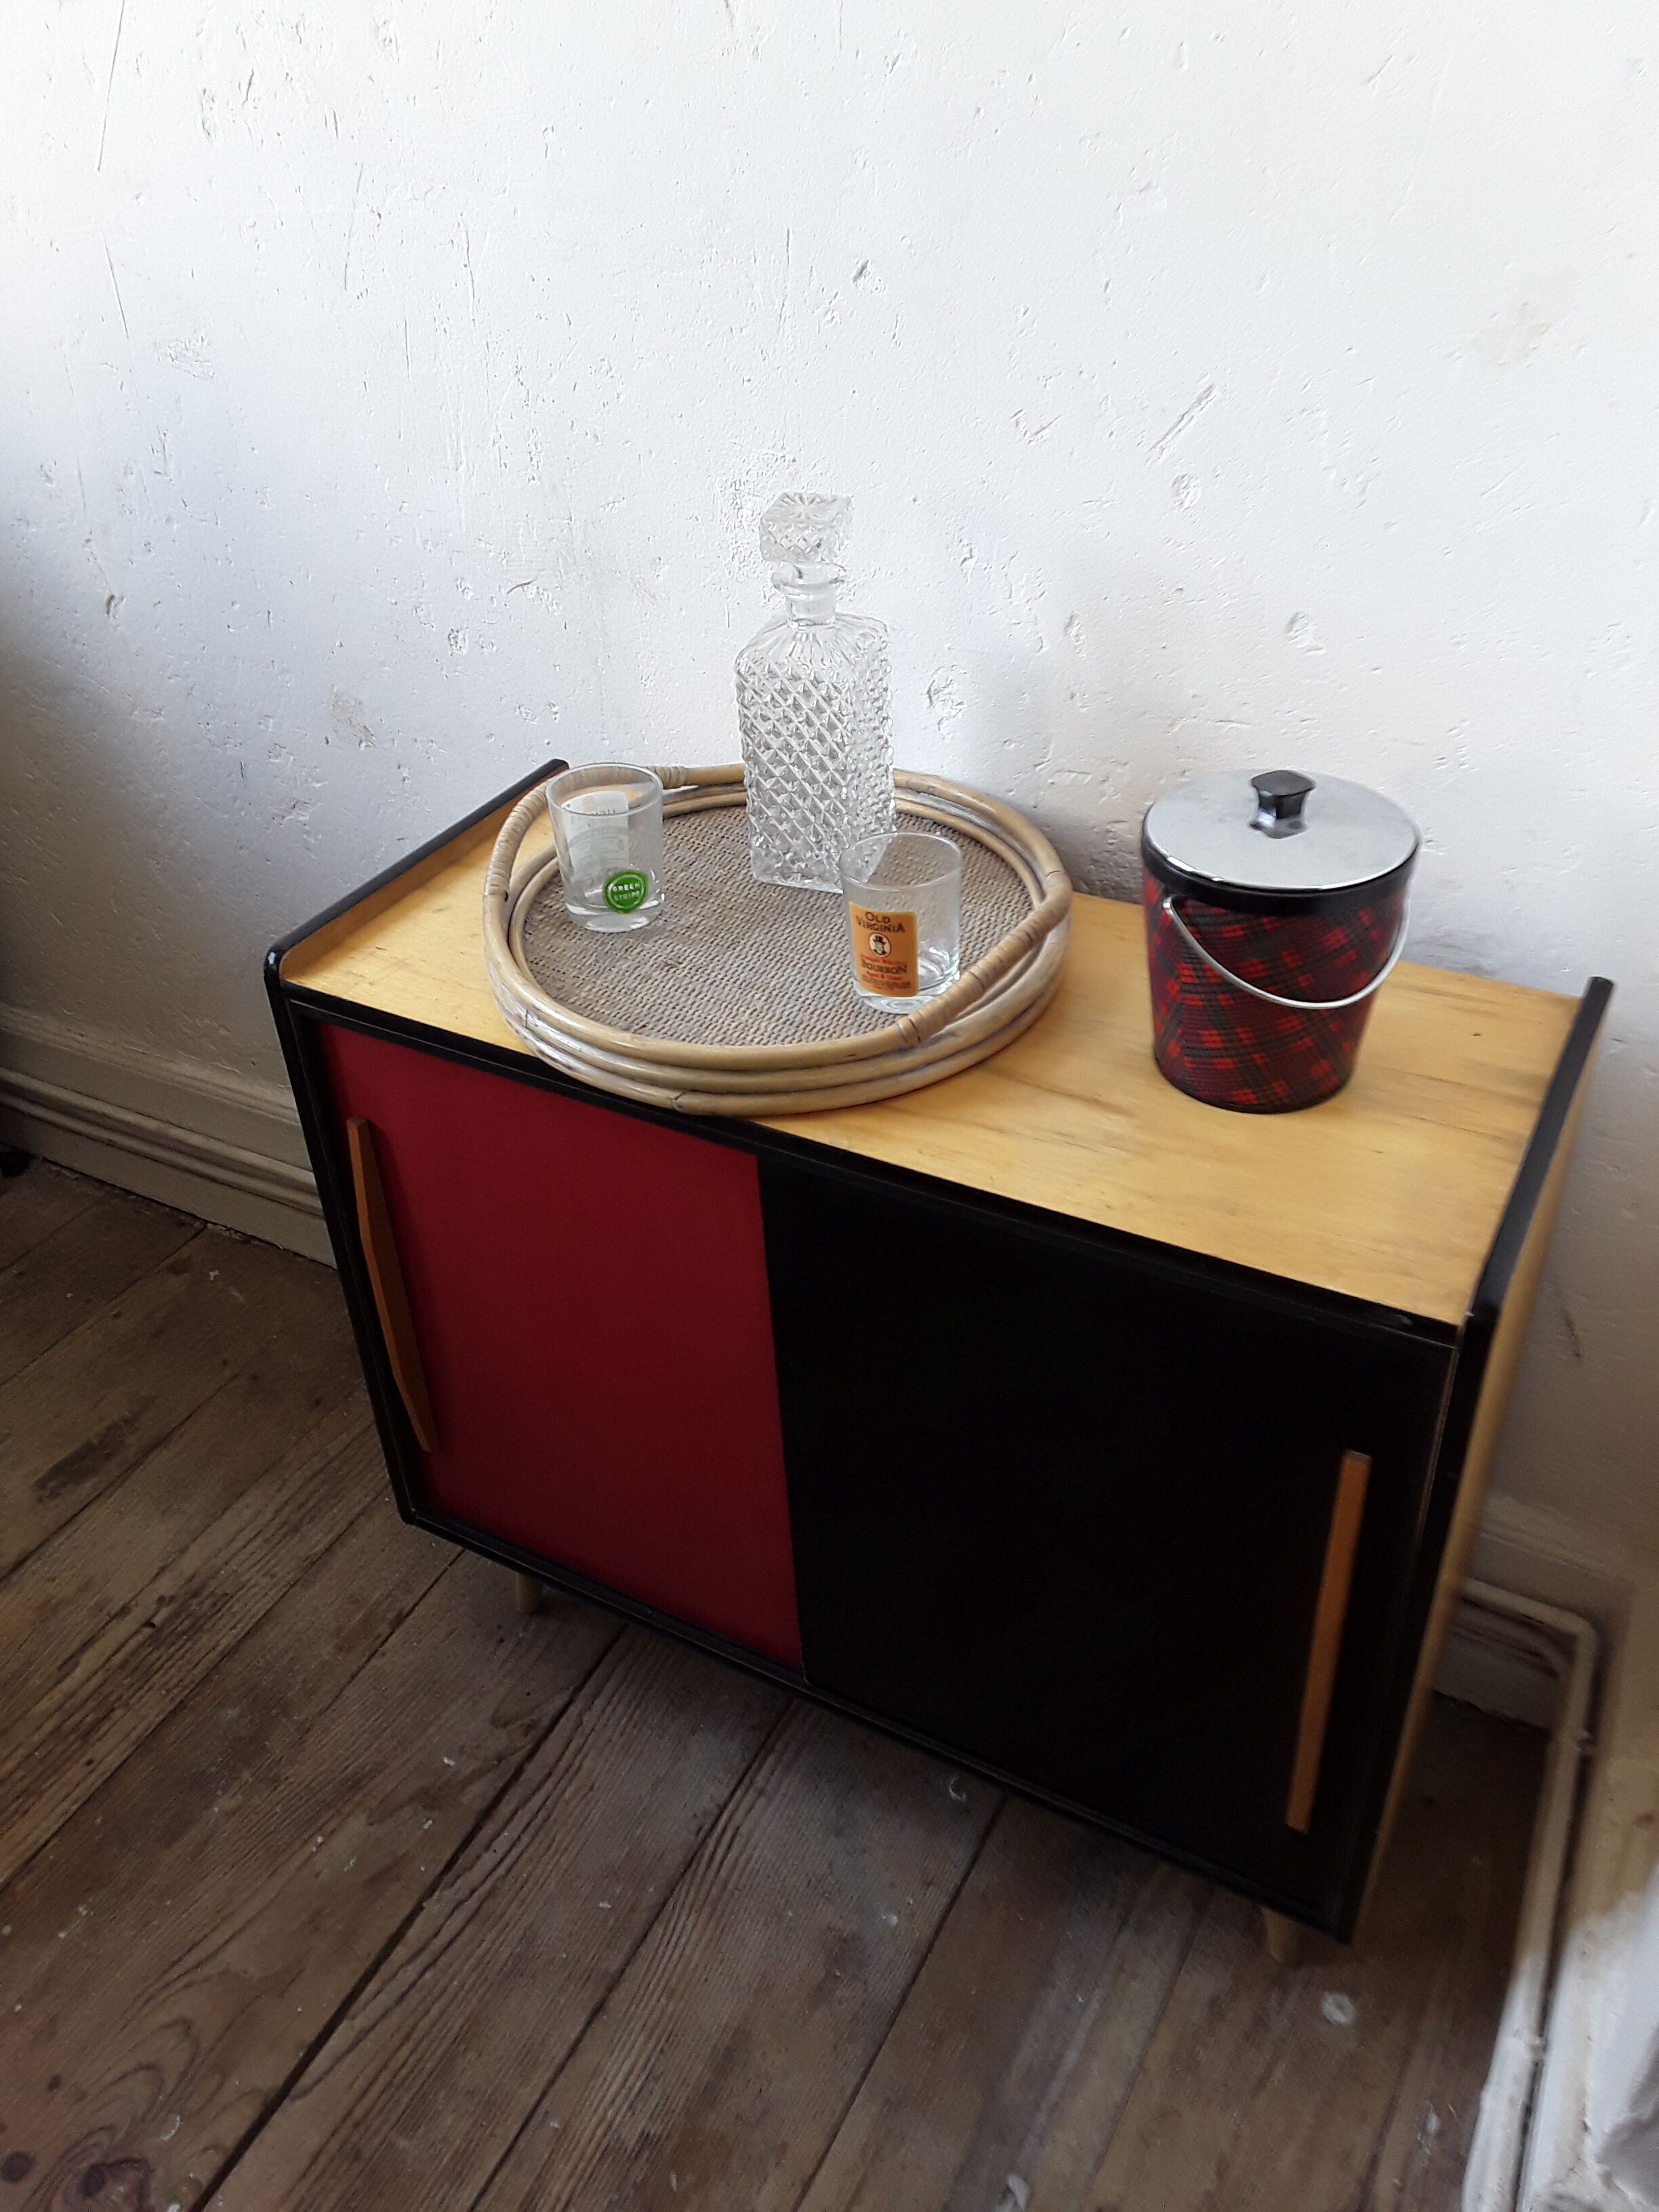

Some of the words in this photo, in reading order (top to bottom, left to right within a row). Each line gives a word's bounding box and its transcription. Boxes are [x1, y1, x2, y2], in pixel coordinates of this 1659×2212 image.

[612, 882, 640, 893] GREEN
[856, 915, 905, 933] VIRGINIA
[865, 912, 890, 924] OLD
